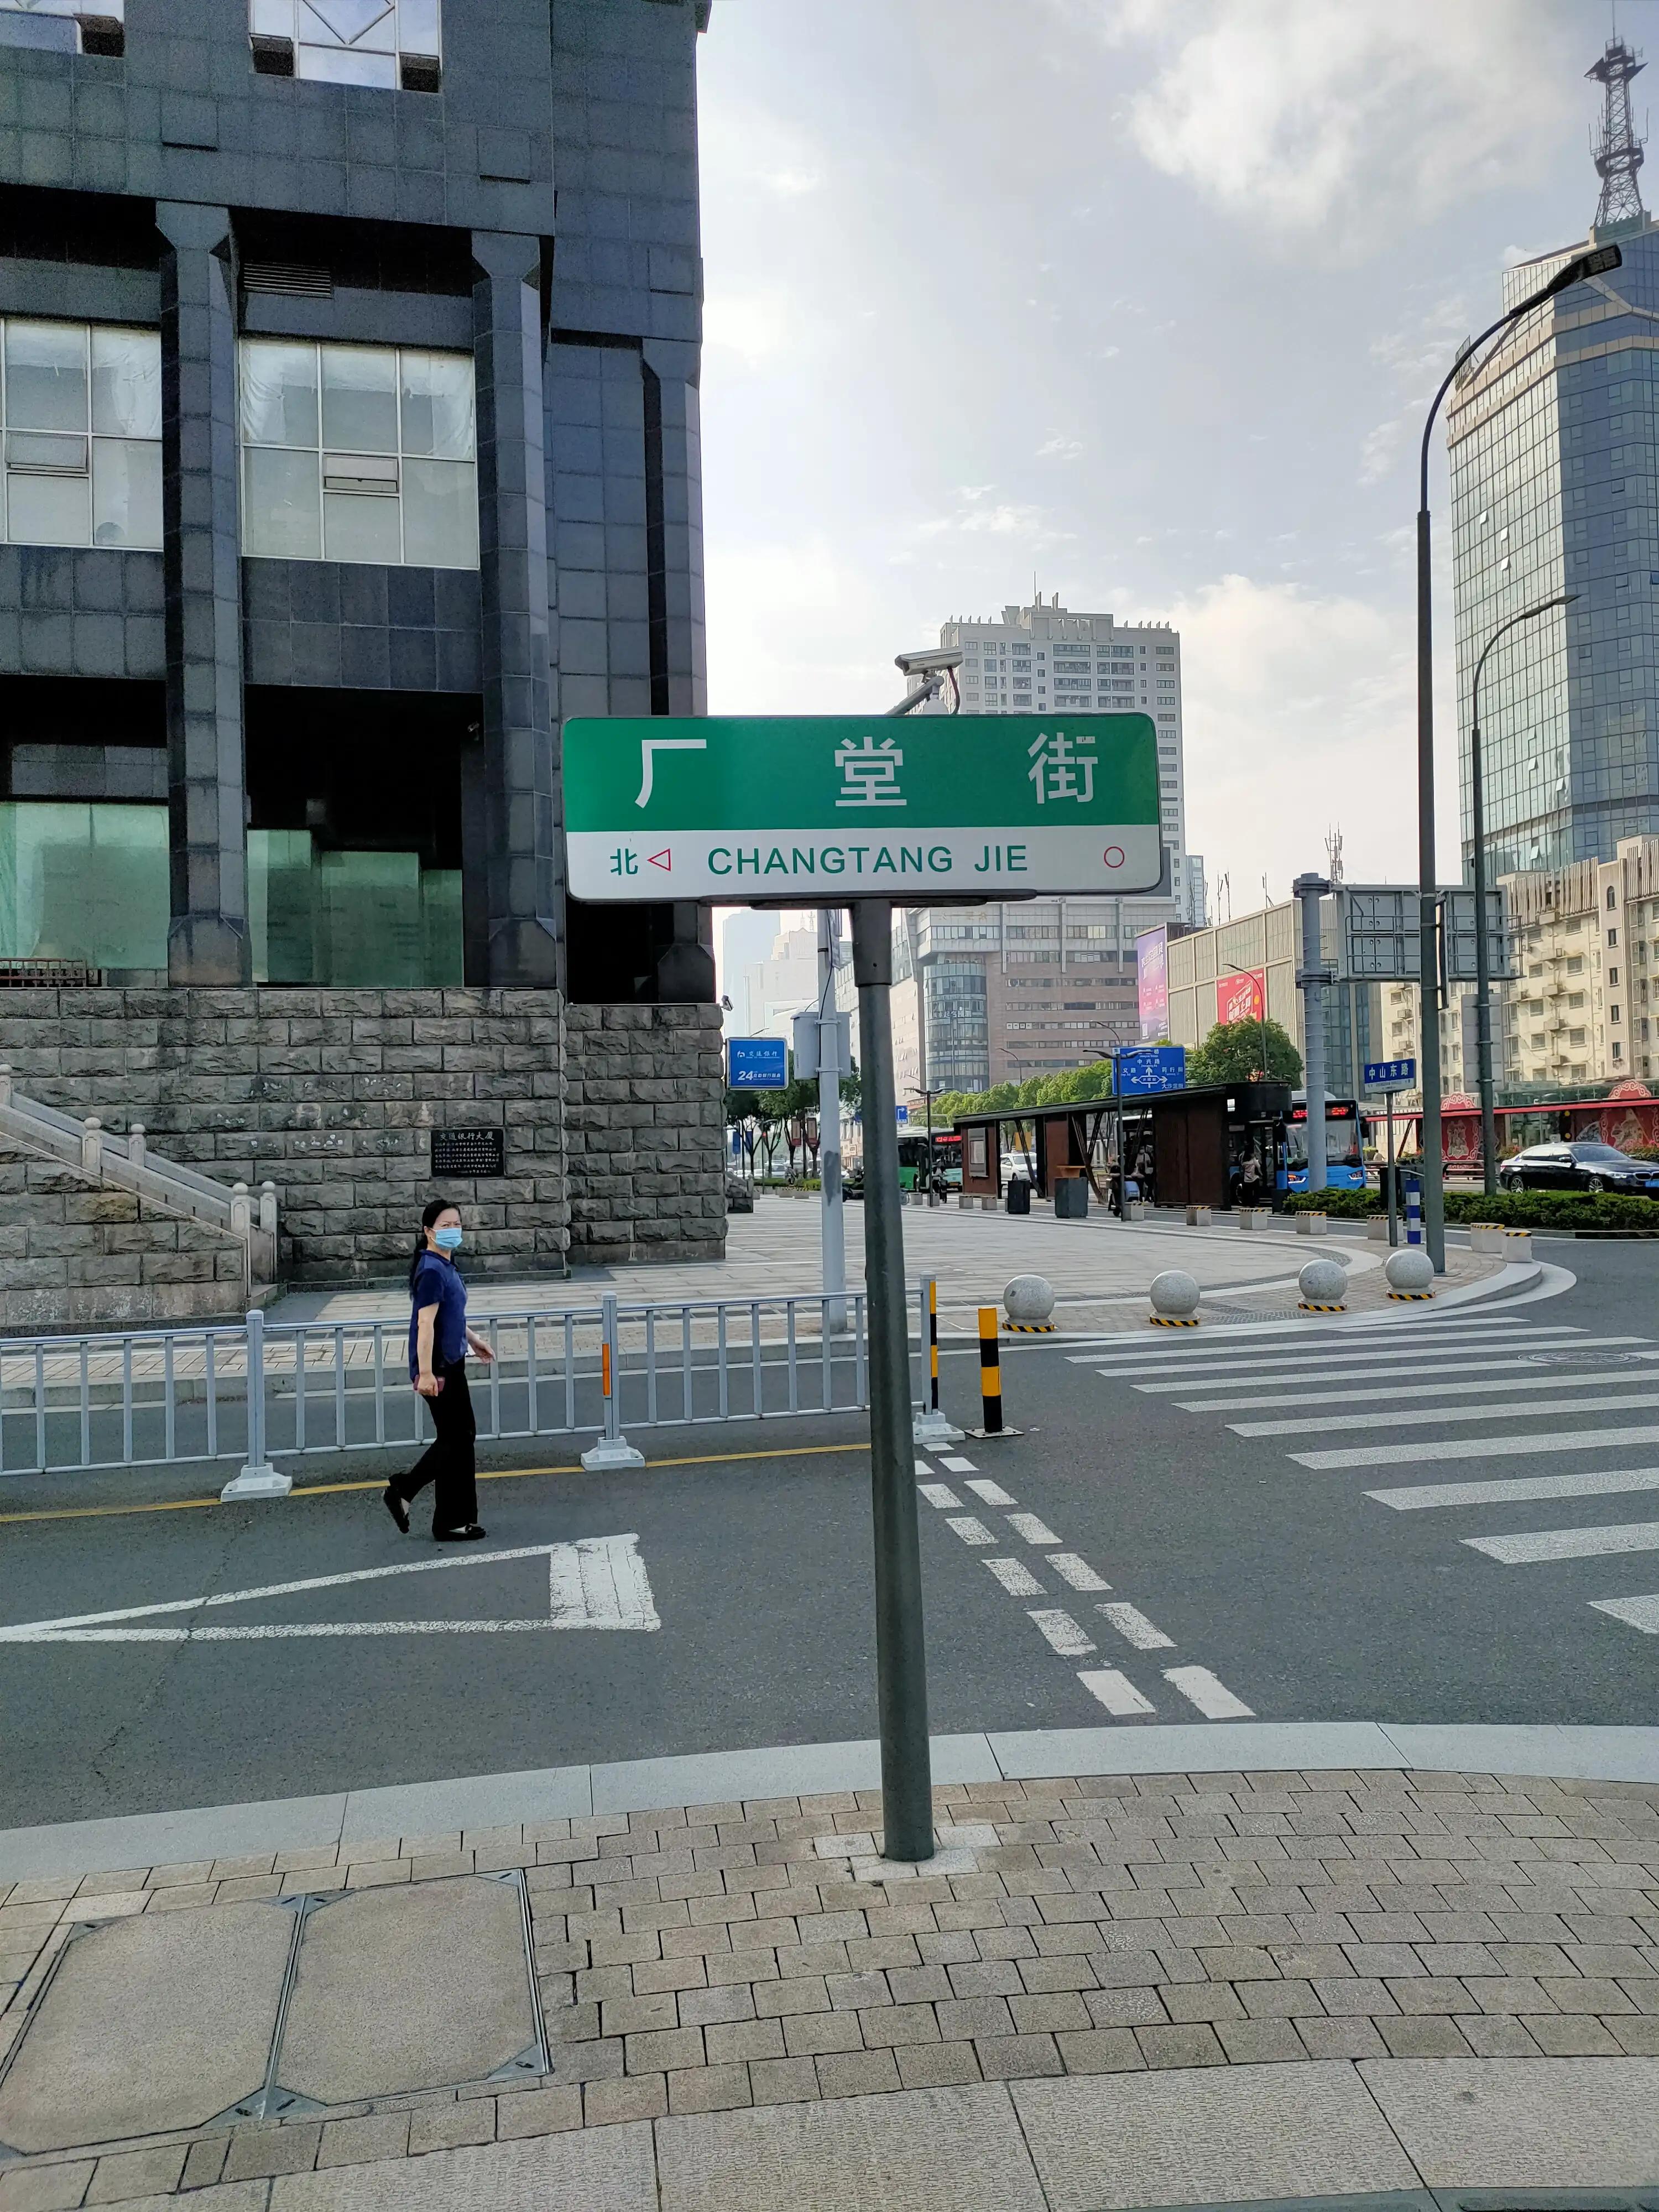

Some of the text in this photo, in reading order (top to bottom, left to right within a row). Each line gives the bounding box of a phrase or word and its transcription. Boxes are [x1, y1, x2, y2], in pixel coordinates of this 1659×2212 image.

[635, 733, 1098, 808] 厂堂街
[611, 848, 638, 876] 北
[707, 844, 1028, 875] CHANGTANG JIE
[737, 1071, 753, 1081] 24
[1369, 1062, 1408, 1081] 中山东路
[440, 1131, 494, 1140] 交通银行大厦
